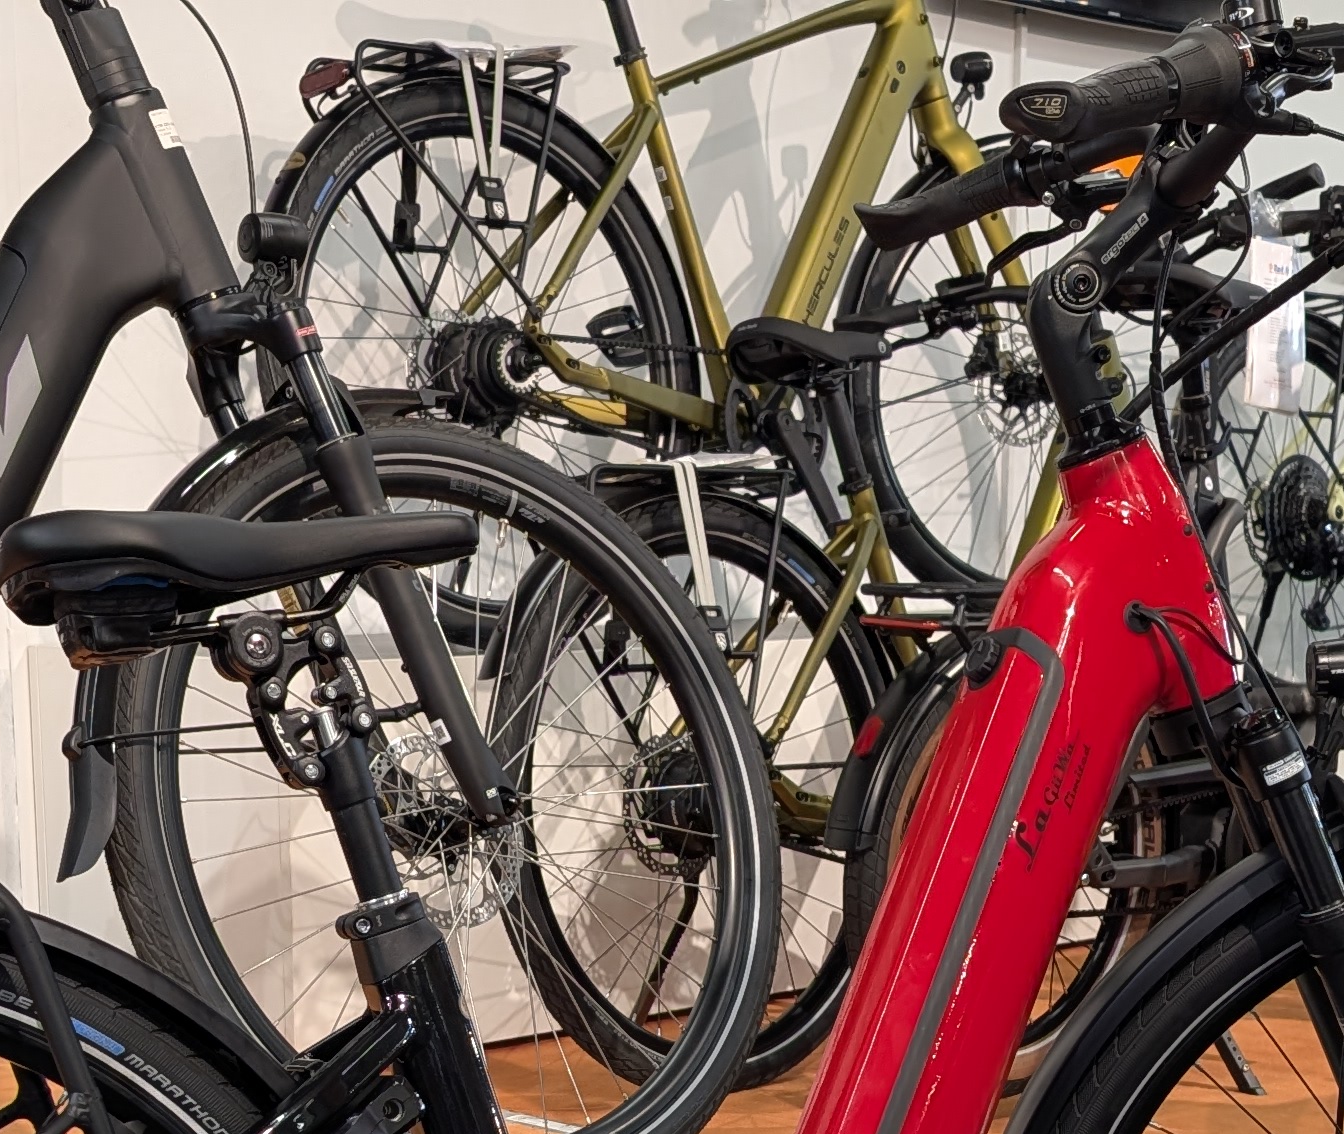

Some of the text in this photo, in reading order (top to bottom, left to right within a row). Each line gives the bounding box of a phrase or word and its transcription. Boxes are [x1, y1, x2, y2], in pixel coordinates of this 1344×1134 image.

[1100, 222, 1141, 265] ergotec
[801, 216, 850, 326] HERCULES
[269, 713, 297, 758] XLC
